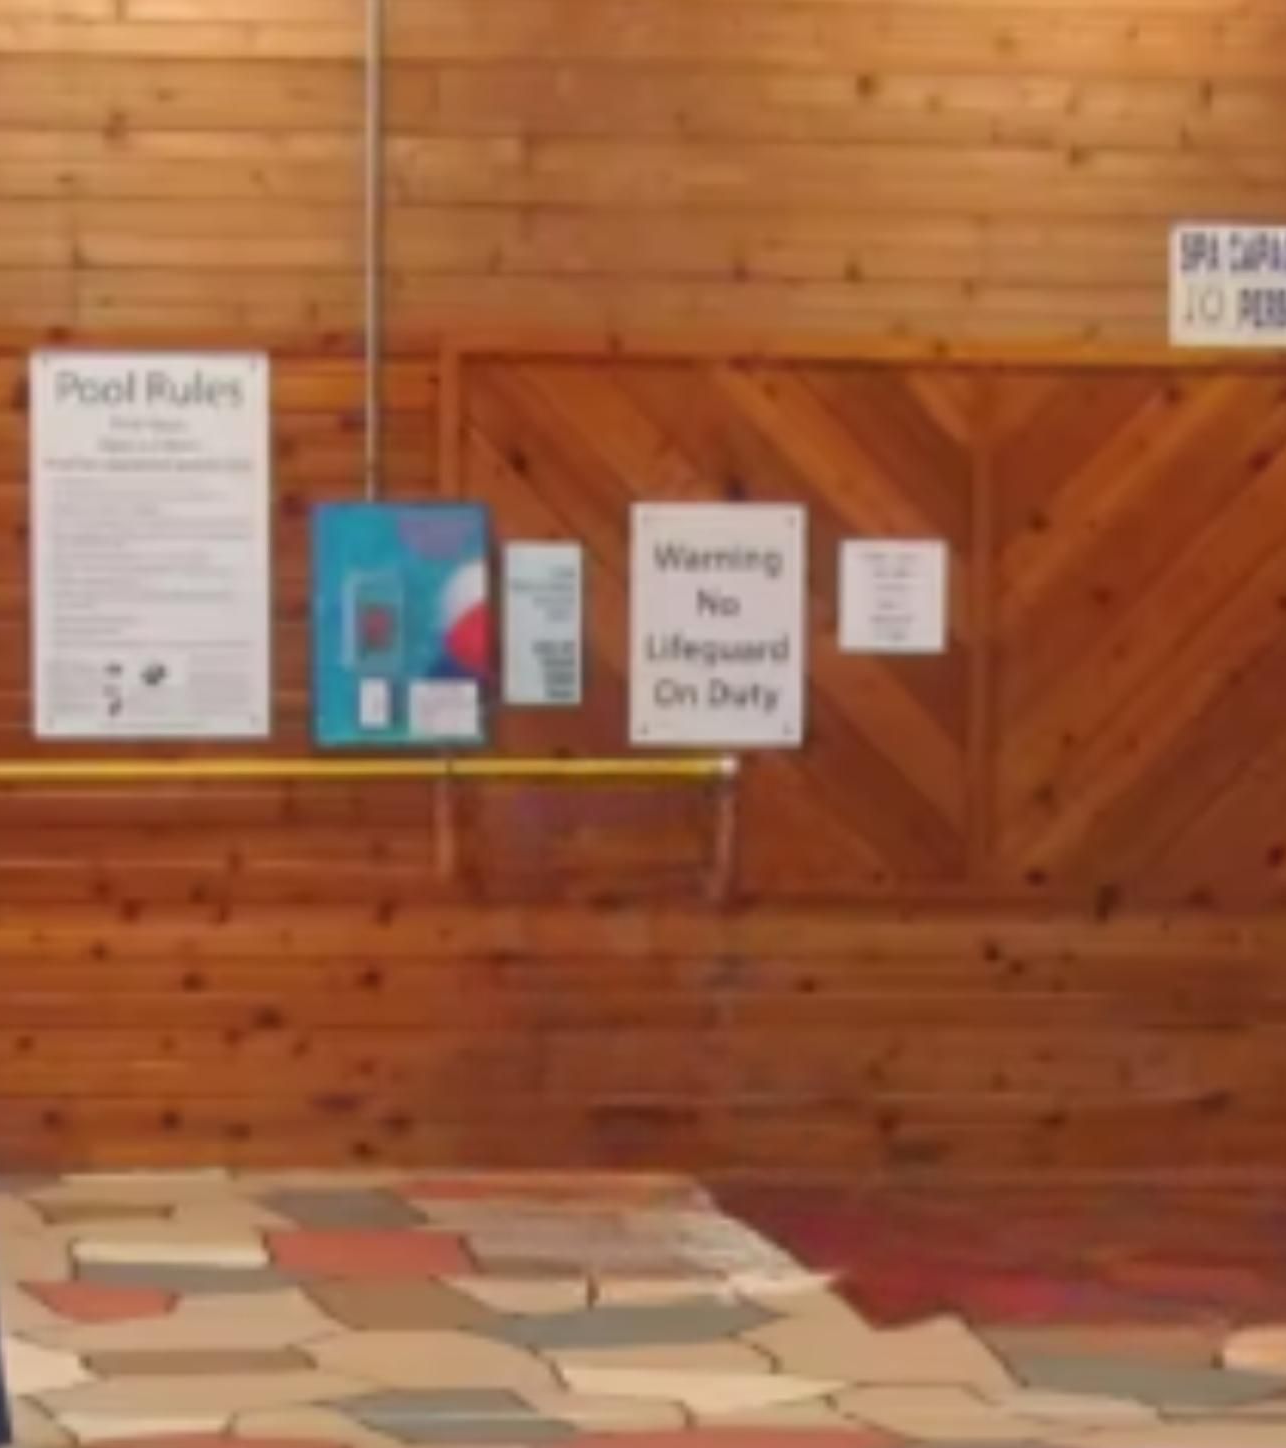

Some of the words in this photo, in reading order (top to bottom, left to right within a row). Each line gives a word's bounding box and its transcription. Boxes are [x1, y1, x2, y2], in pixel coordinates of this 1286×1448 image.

[1180, 233, 1220, 271] SPA
[55, 369, 136, 406] Pool
[146, 369, 245, 407] Rules
[652, 543, 784, 579] Warning
[695, 589, 742, 617] No
[645, 632, 791, 665] Lifeguard
[652, 677, 699, 706] On
[708, 677, 780, 714] Duty
